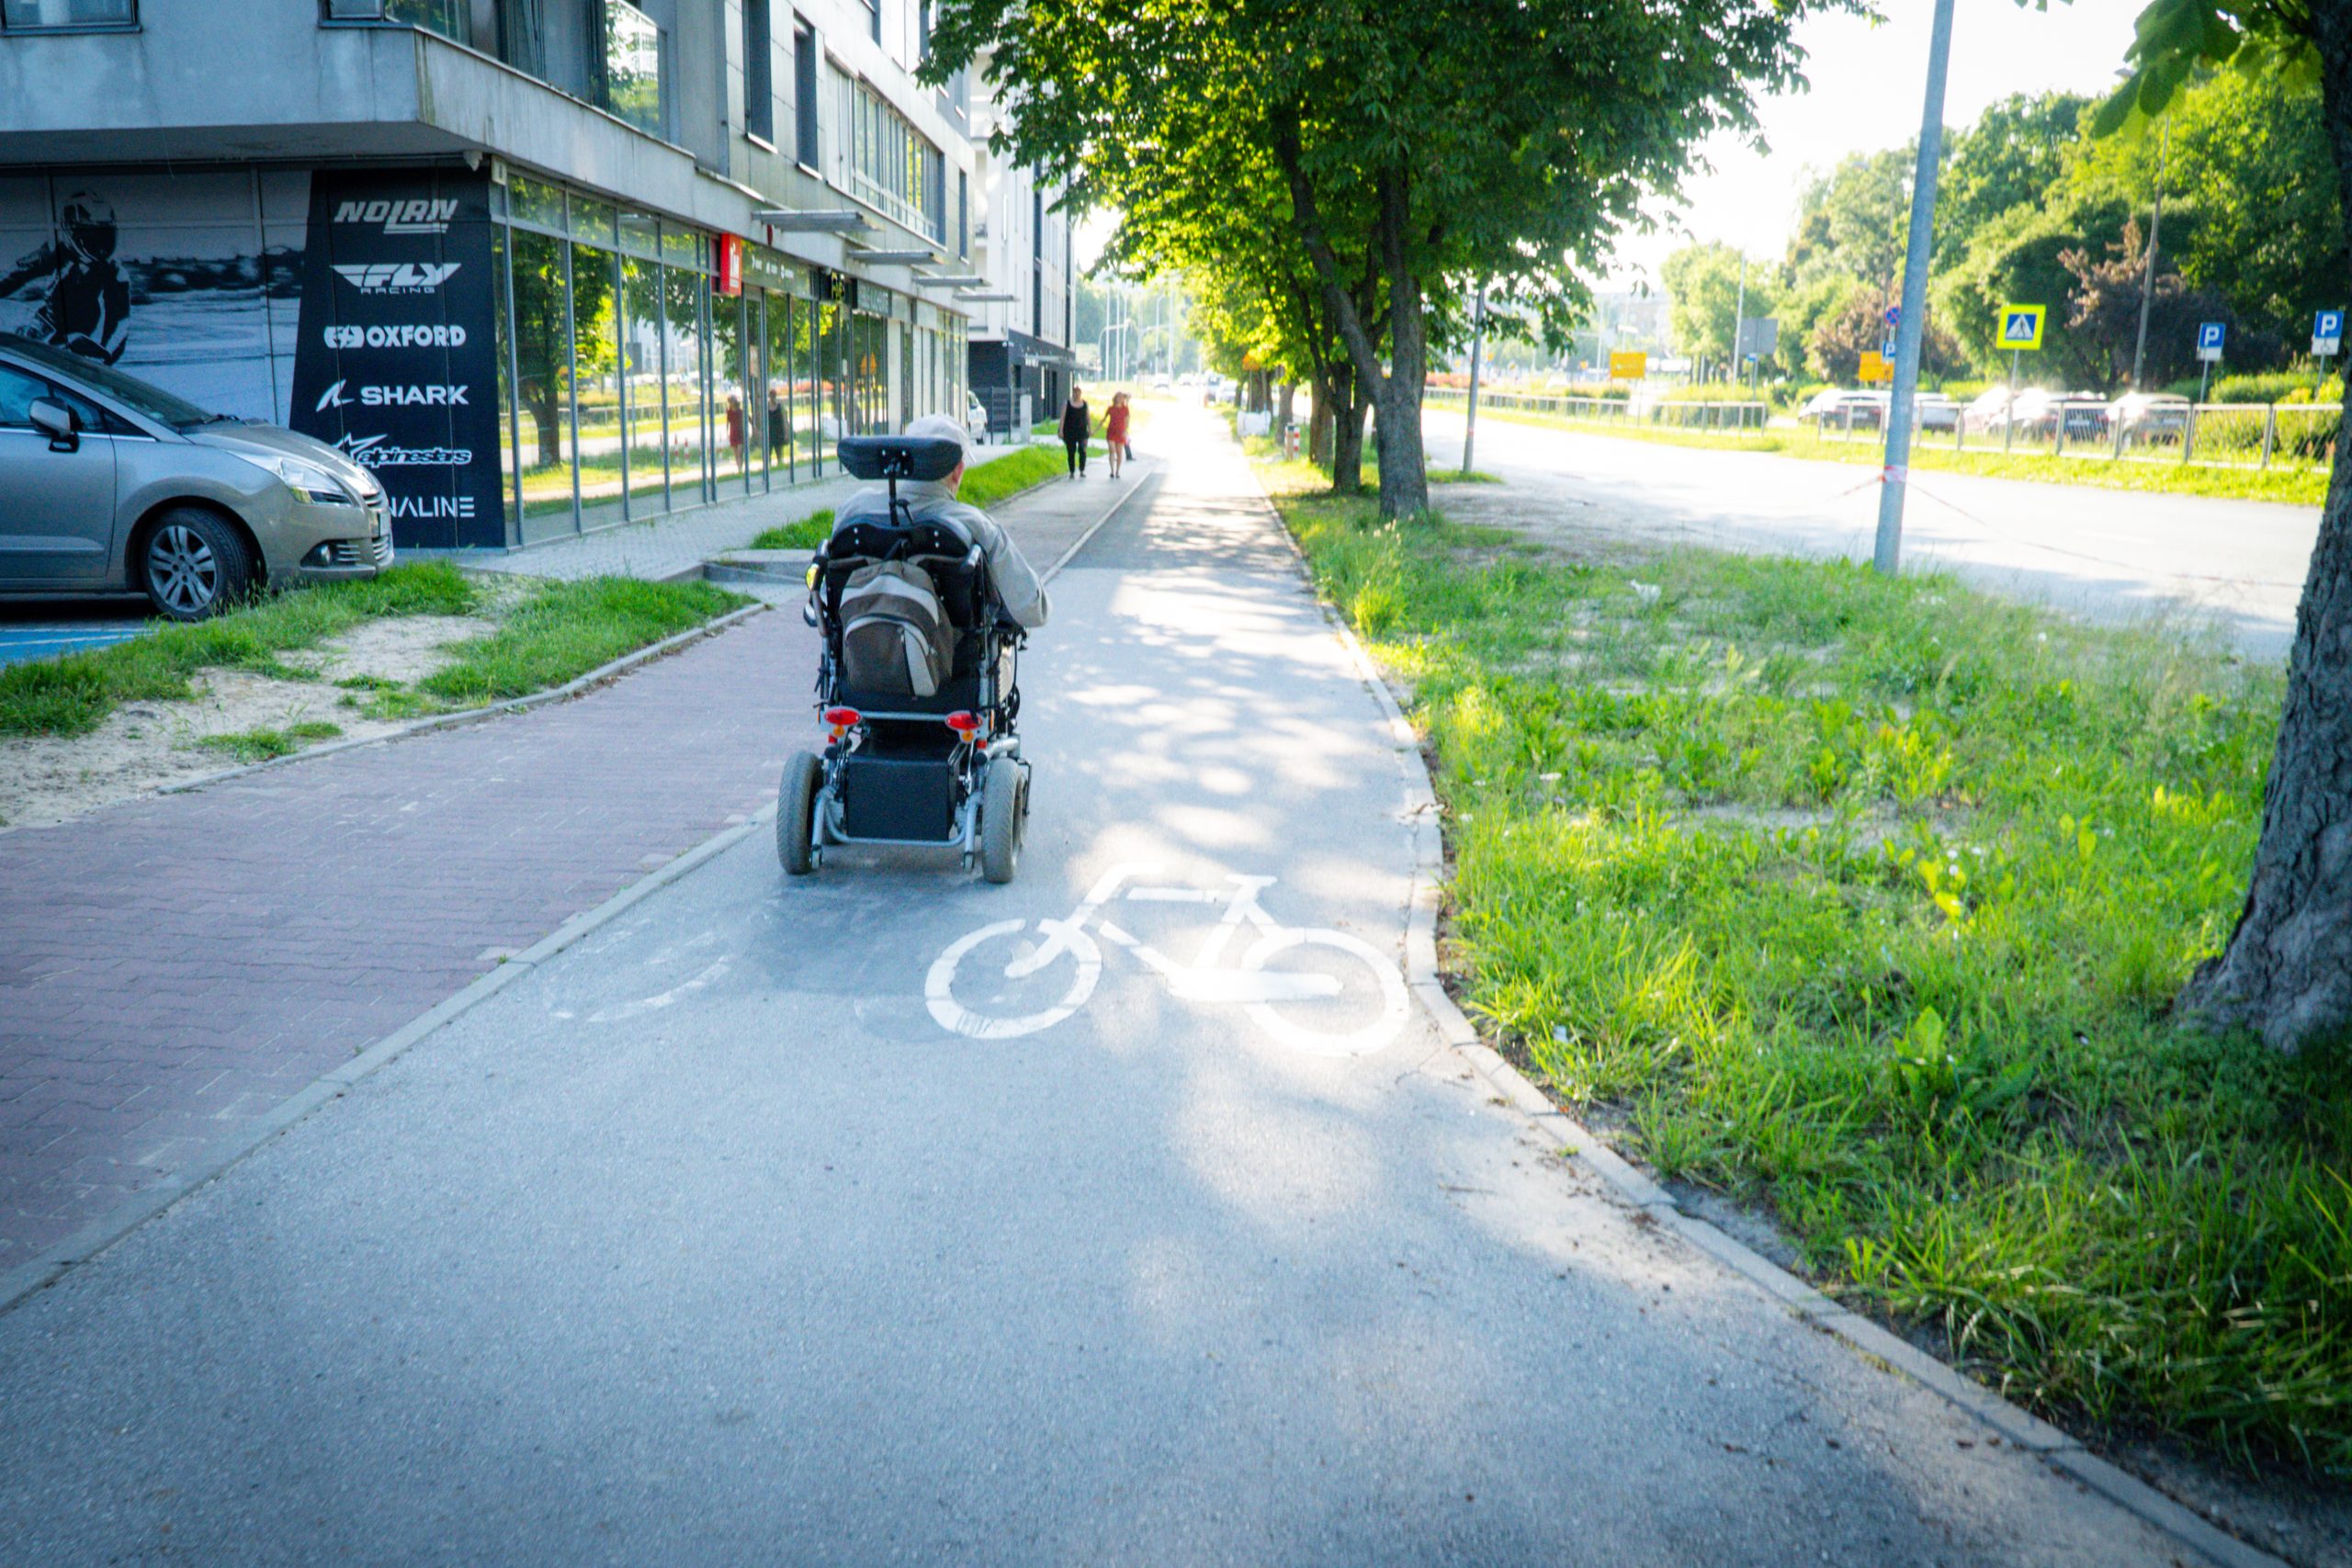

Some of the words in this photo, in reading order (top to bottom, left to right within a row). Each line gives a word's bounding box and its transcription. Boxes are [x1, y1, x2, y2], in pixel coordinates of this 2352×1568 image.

[334, 198, 458, 234] NOLAN
[360, 287, 435, 295] RACING
[2319, 313, 2337, 336] P
[367, 325, 467, 347] OXFORD
[2204, 326, 2220, 345] P
[360, 385, 469, 405] SHARK
